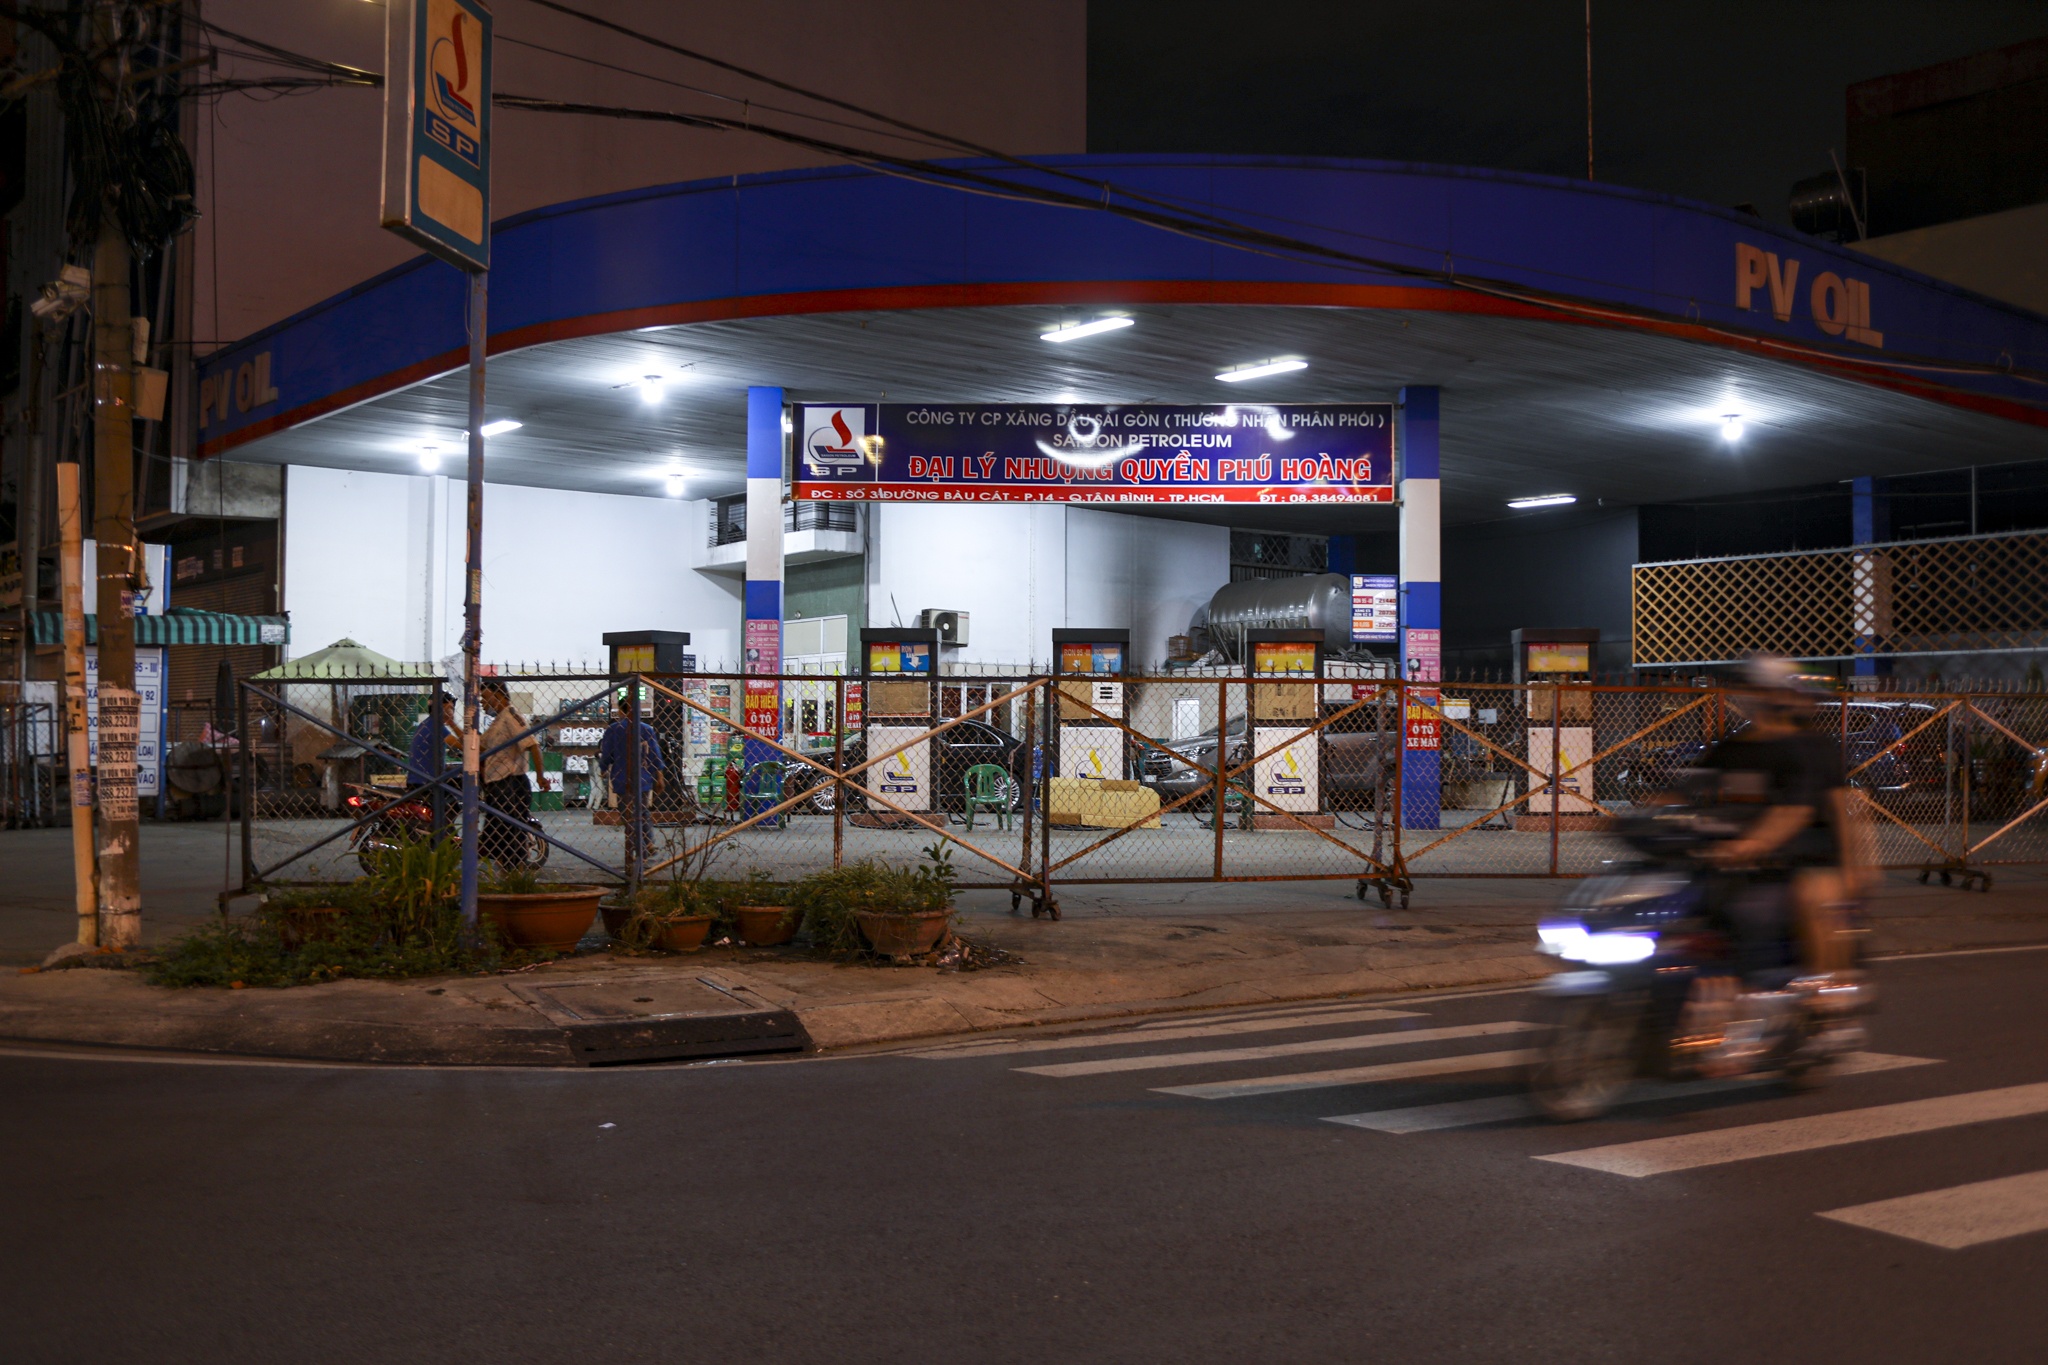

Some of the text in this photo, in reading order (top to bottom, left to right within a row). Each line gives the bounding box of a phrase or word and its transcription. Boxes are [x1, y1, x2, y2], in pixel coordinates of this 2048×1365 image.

[432, 118, 474, 154] SP
[1735, 242, 1883, 349] PV OIL
[200, 351, 278, 429] PV OIL
[906, 408, 954, 425] CÔNG
[959, 411, 976, 425] TY
[981, 411, 1002, 426] CP
[1006, 410, 1053, 426] XĂNG
[1057, 407, 1090, 427] DẦU
[1095, 409, 1119, 427] SÀI
[1123, 410, 1160, 427] GÒN
[1292, 411, 1334, 427] PHÂN
[1128, 433, 1232, 448] PETROLEUM
[908, 455, 954, 482] ĐẠI
[962, 451, 997, 479] LÝ
[1120, 449, 1210, 484] QUYỀN
[1217, 453, 1272, 481] PHÚ
[1280, 452, 1372, 482] HOÀNG
[810, 489, 833, 499] ĐC
[846, 487, 866, 499] SỐ
[979, 489, 1010, 501] CÁT
[1024, 492, 1054, 502] P.14
[1068, 491, 1120, 503] Q.TÂN
[1121, 491, 1154, 502] BÌNH
[1168, 493, 1225, 503] TP.HCM
[1259, 493, 1278, 503] ĐT
[1289, 494, 1379, 503] 08.38494081
[145, 690, 155, 701] 92
[745, 690, 759, 709] BẢO
[750, 711, 772, 724] Ô TÔ
[758, 724, 777, 737] MÁY
[1411, 722, 1434, 735] Ô TÔ
[1406, 735, 1439, 748] XE MÁY
[138, 770, 155, 785] VÀO
